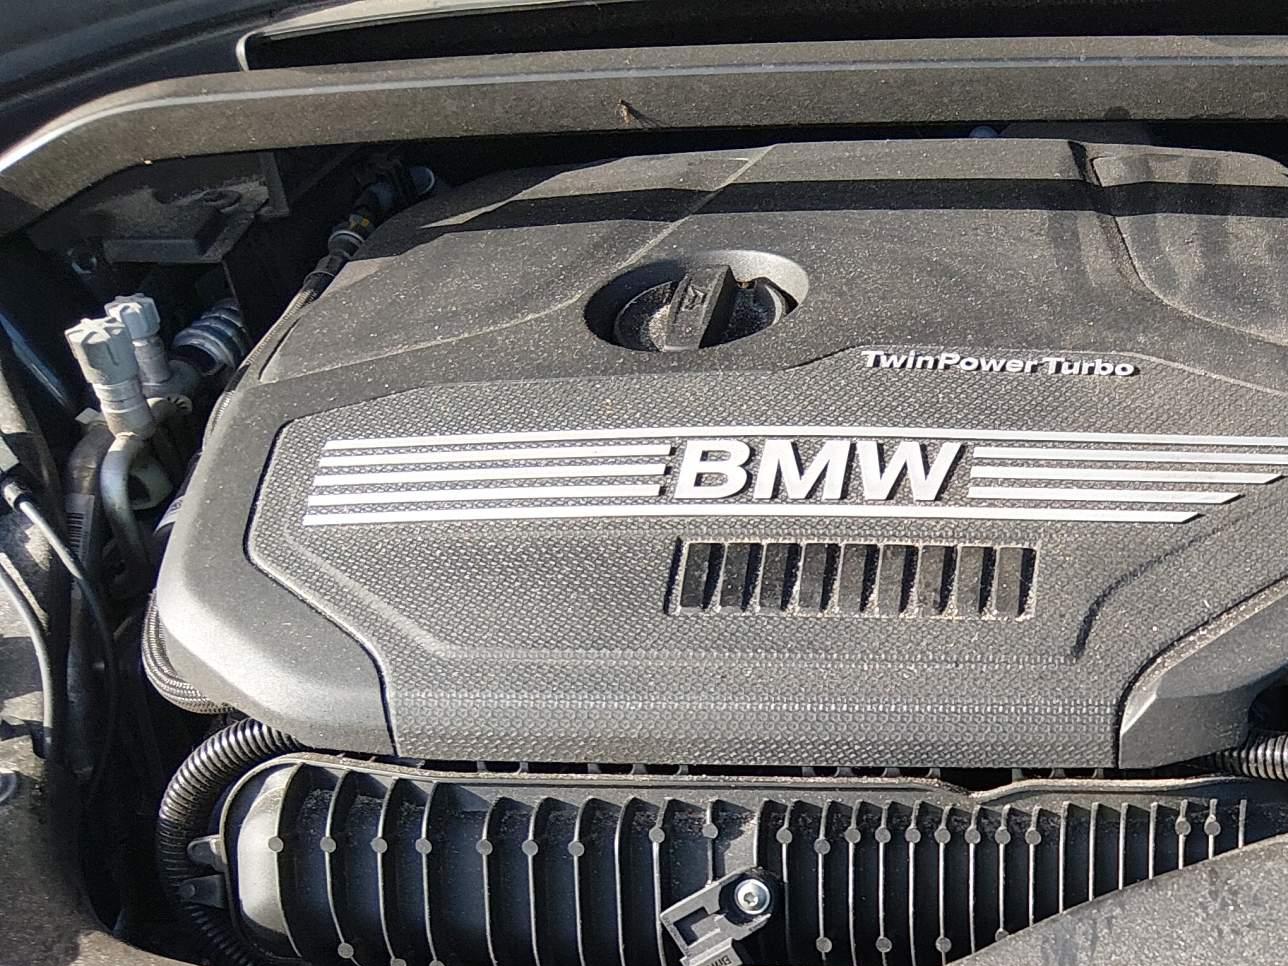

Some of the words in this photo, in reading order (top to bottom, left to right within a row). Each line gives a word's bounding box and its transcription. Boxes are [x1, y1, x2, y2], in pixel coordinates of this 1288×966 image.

[860, 350, 1041, 374] TwinPower
[1042, 357, 1138, 376] Turbo
[673, 439, 964, 501] BMW
